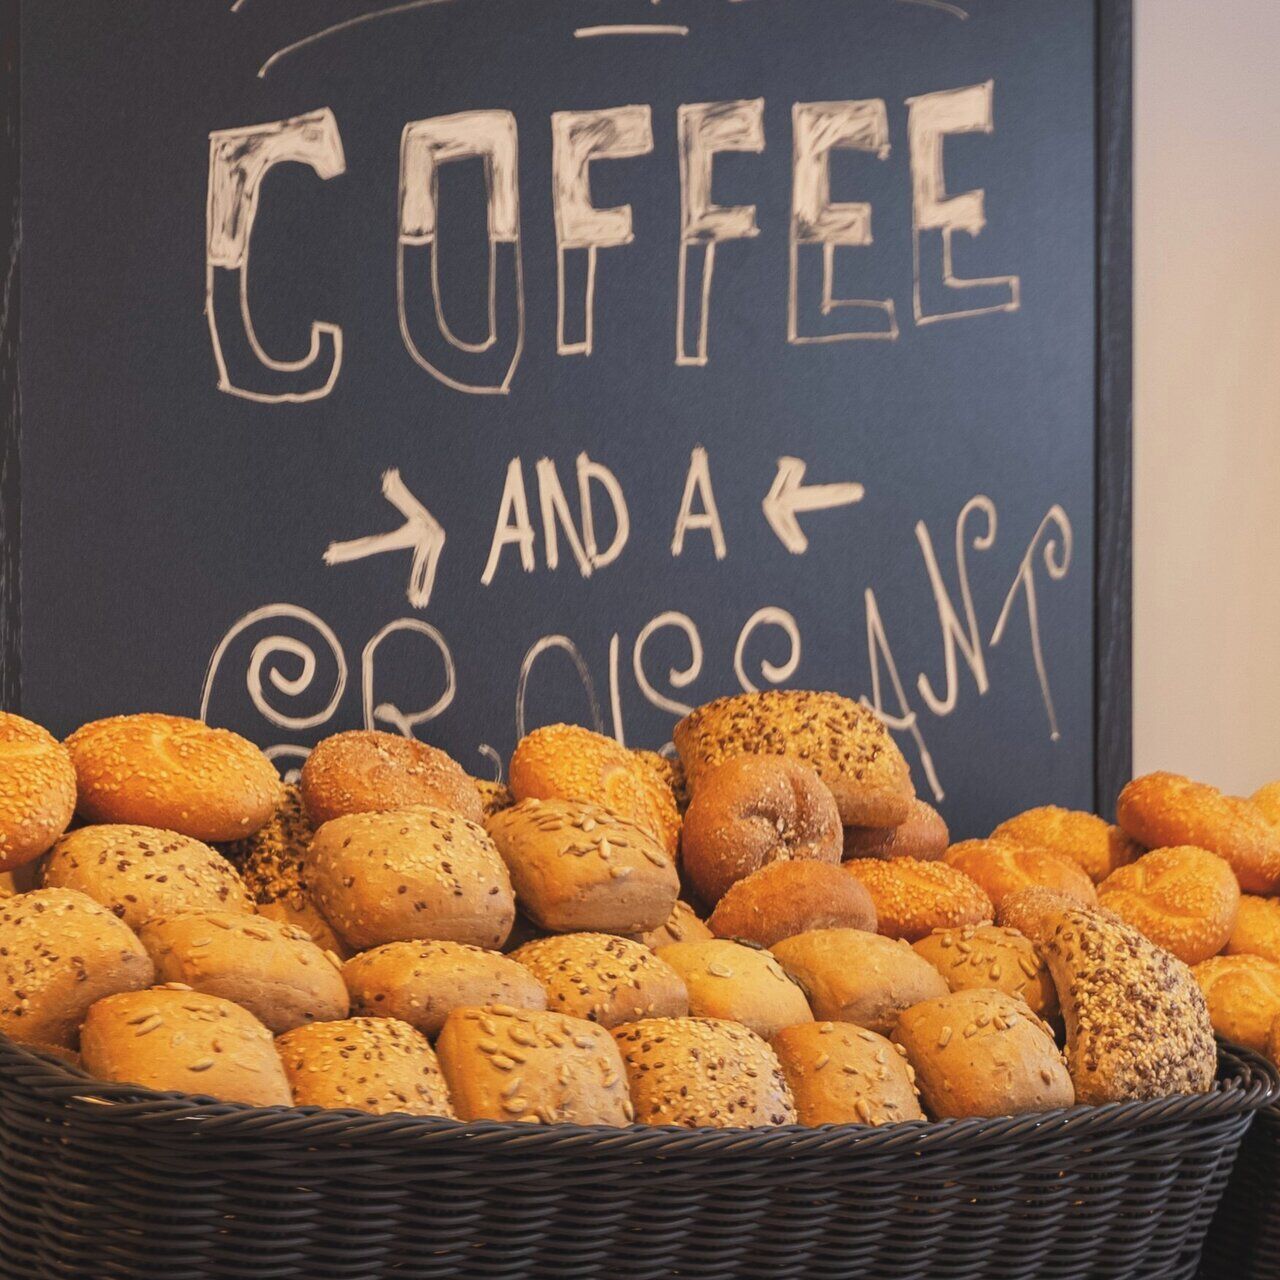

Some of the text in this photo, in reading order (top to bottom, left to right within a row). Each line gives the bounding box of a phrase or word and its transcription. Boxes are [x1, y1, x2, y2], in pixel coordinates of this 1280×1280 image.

[206, 80, 1019, 402] COFFEE
[482, 444, 728, 584] AND A
